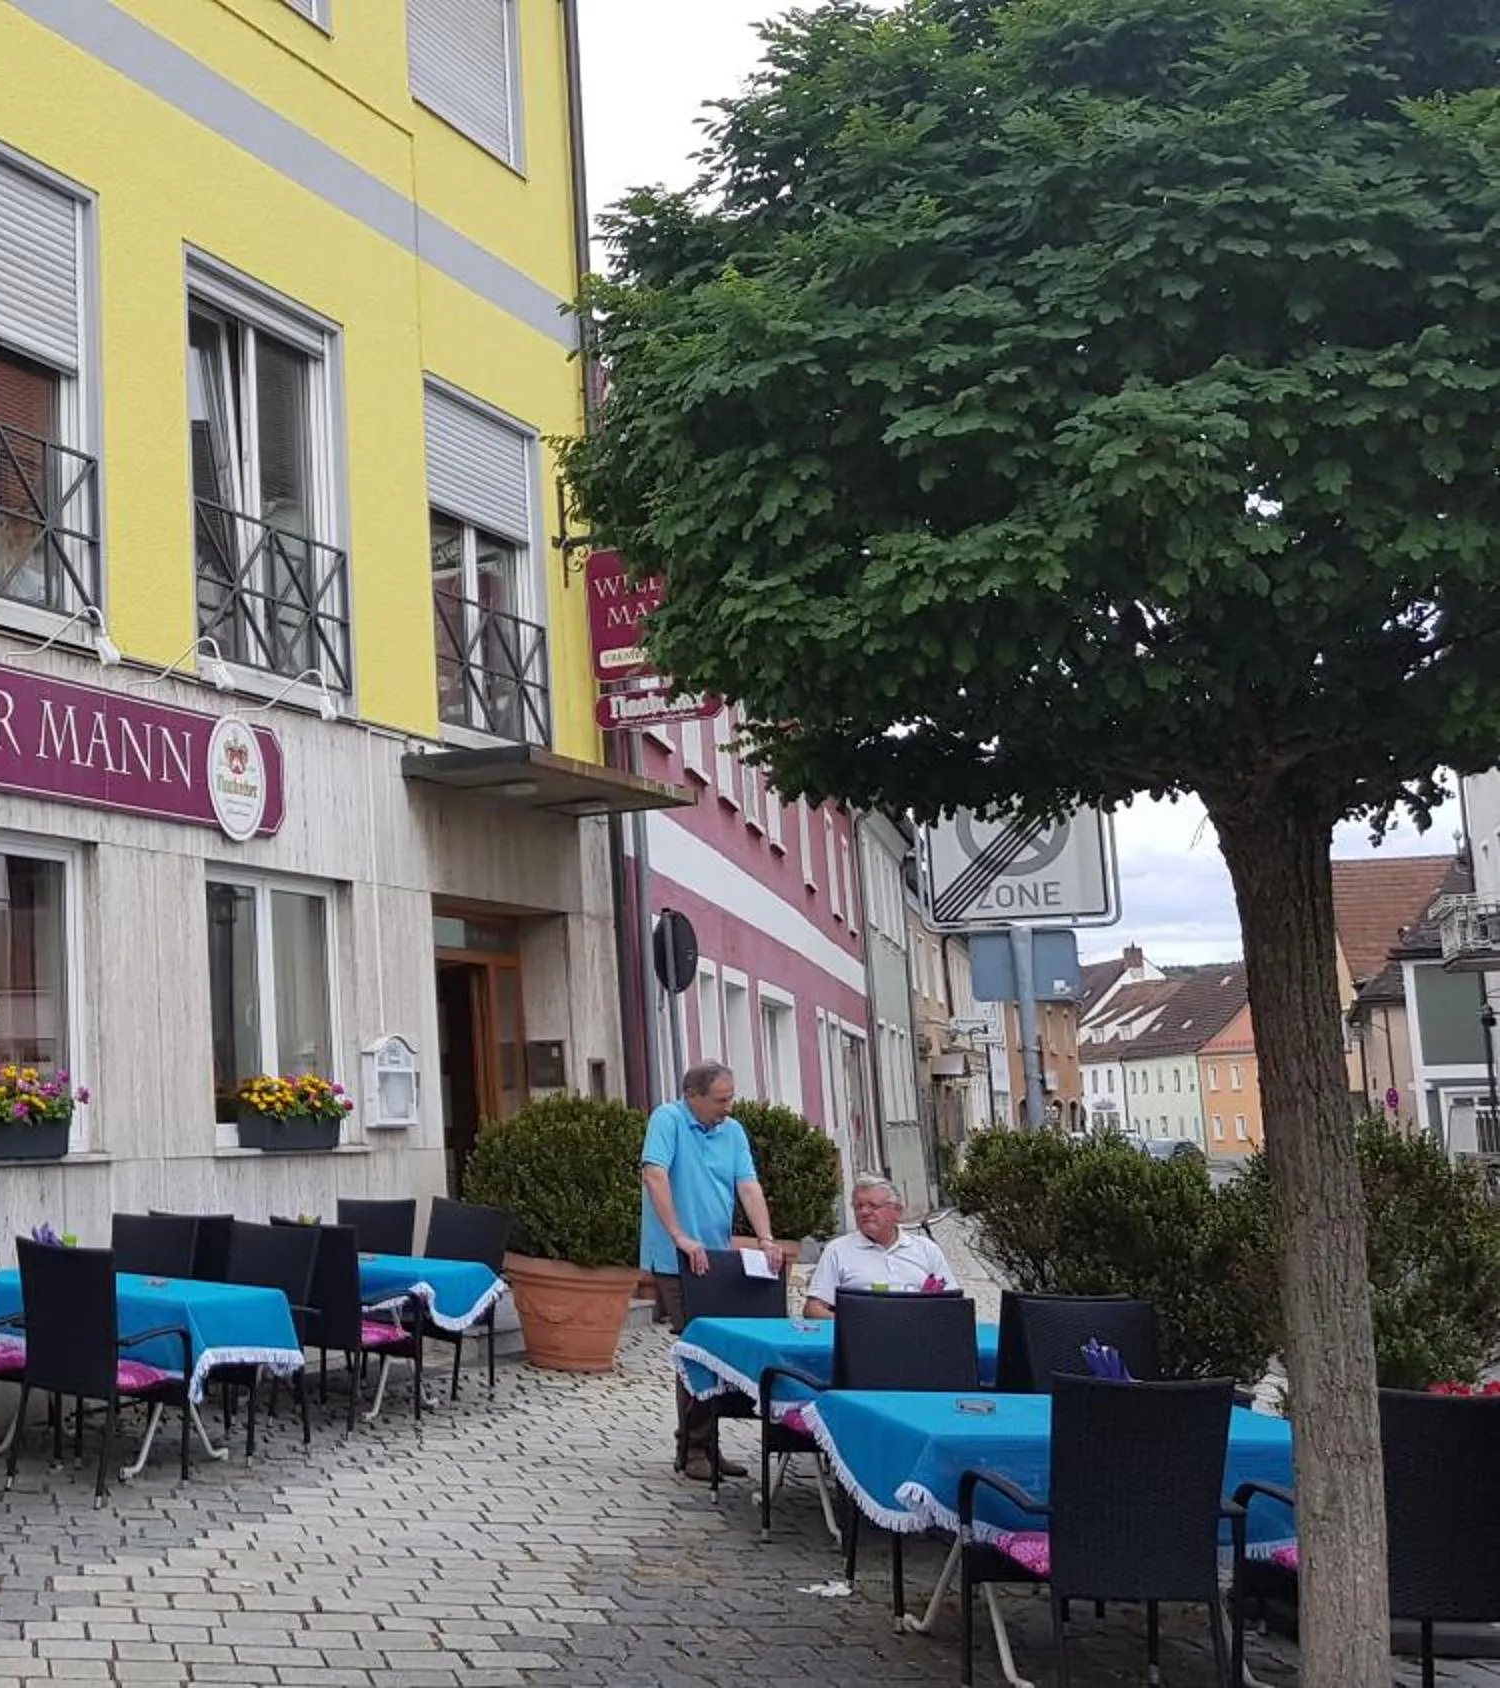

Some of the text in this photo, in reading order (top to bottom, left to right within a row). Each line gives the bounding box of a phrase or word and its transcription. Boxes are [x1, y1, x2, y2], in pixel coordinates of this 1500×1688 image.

[607, 600, 660, 629] MA
[35, 698, 192, 791] MANN
[976, 881, 1062, 910] ZONE
